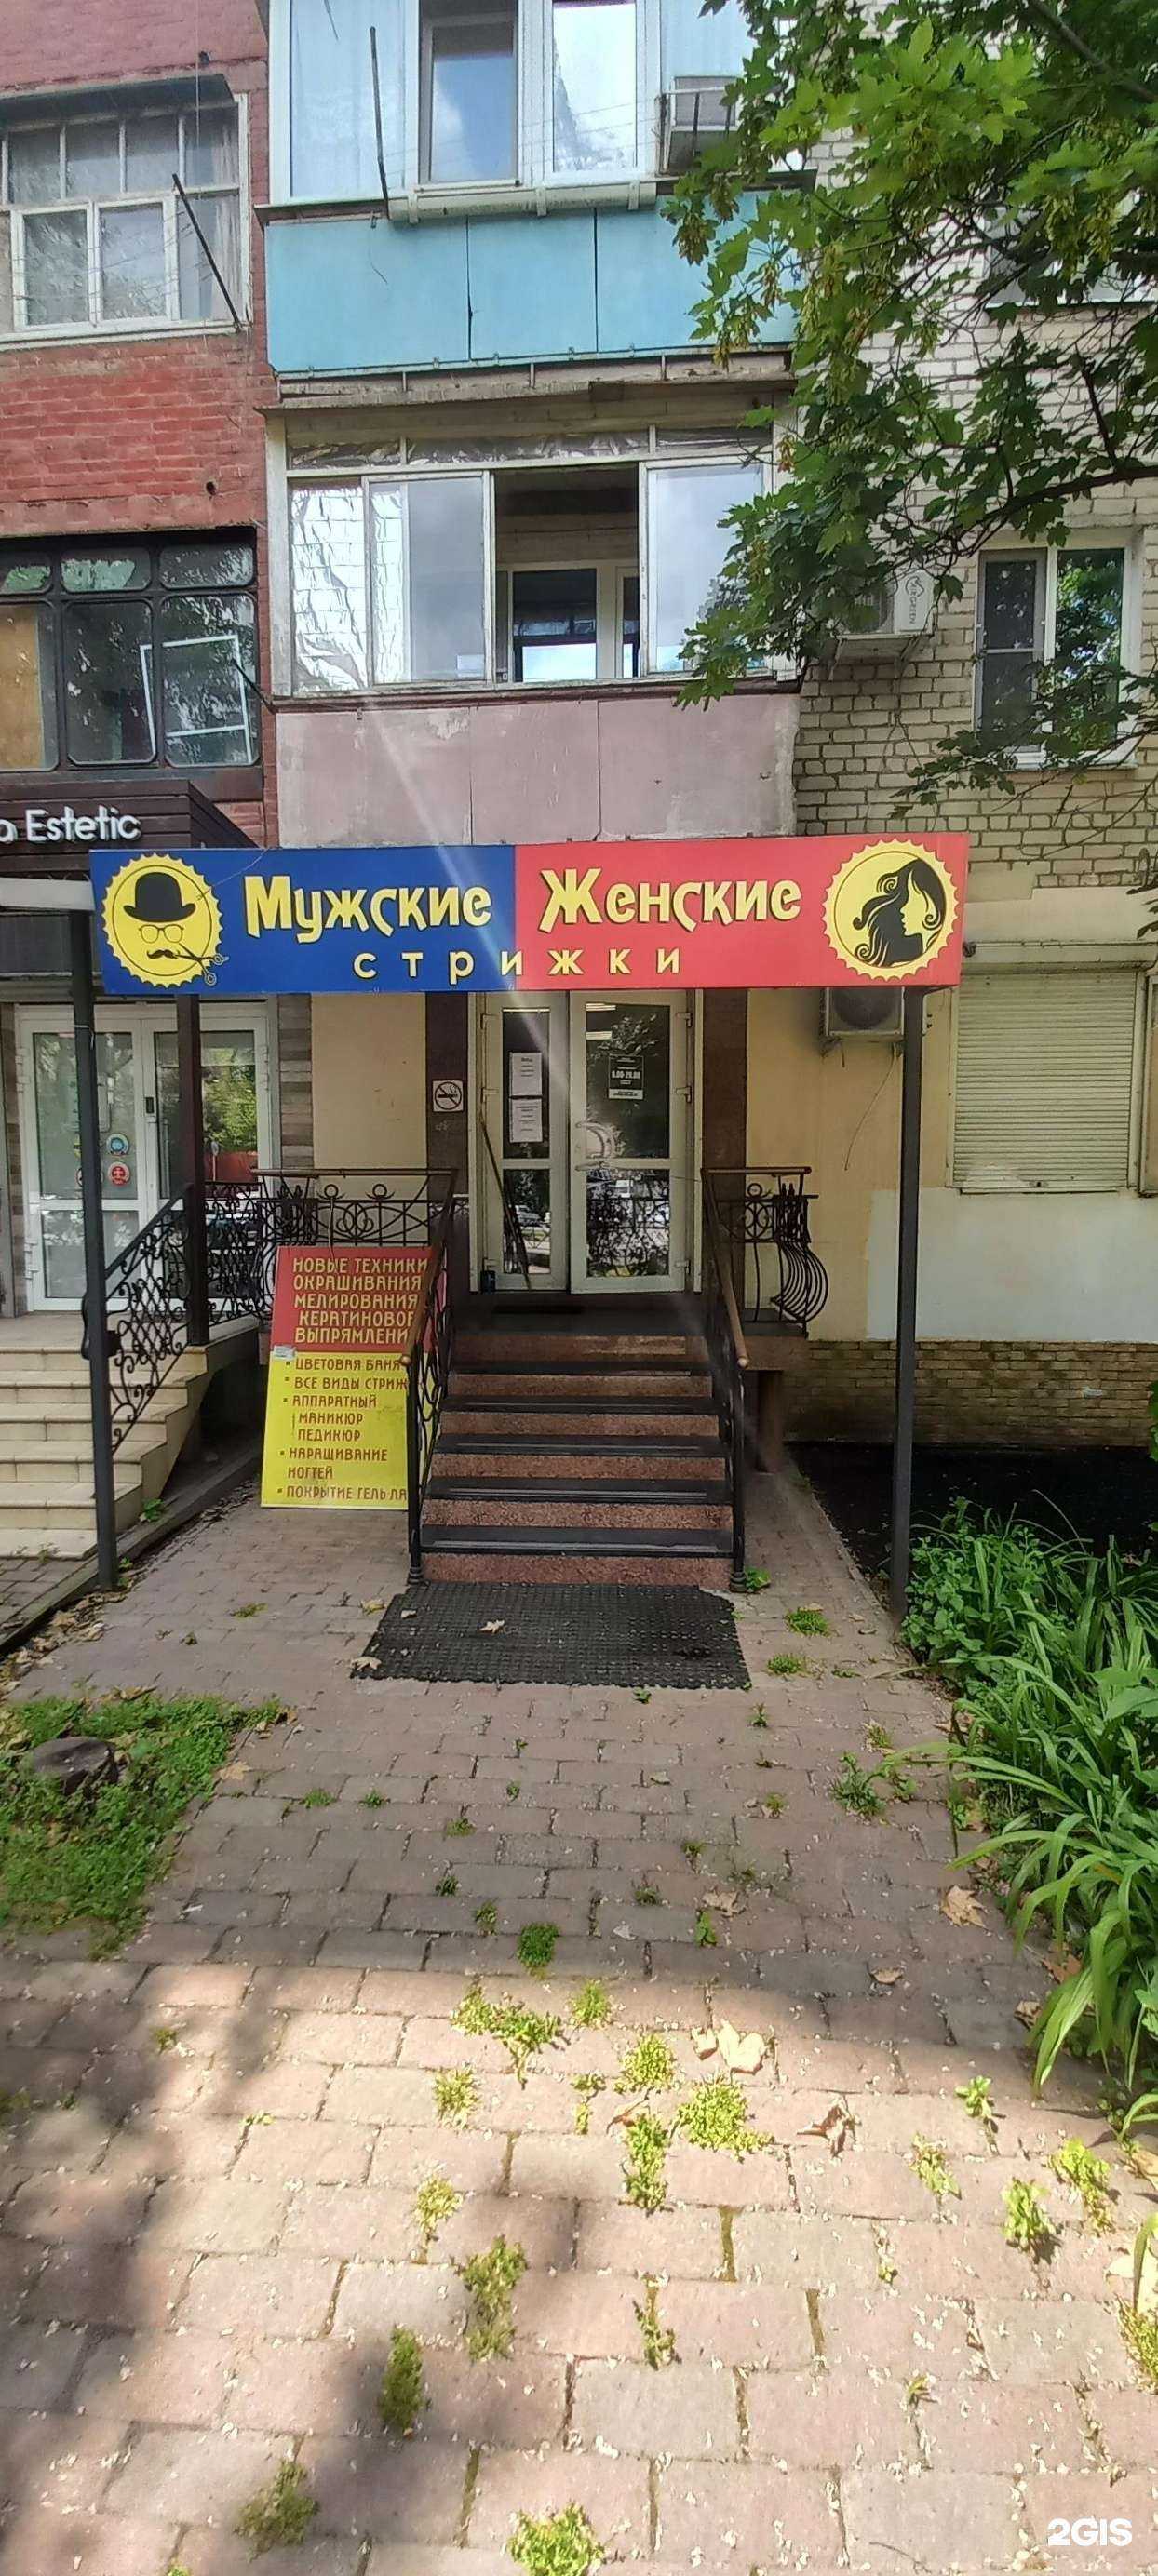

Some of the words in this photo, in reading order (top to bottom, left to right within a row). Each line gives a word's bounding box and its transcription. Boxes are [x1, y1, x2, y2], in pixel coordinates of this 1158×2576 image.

[25, 805, 141, 842] Estetic
[243, 874, 492, 944] Мужские
[538, 867, 802, 933] Женские
[353, 947, 680, 985] стрижки
[293, 1257, 347, 1274] НОВЫЕ
[355, 1257, 428, 1274] ТЕХНИКИ
[293, 1274, 422, 1292] ОКРАШИВАНИЯ
[294, 1293, 418, 1309] МЕЛИРОВАНИЯ
[295, 1327, 410, 1344] ВЫПРЯМЛЕНИ
[295, 1358, 361, 1372] ЦВЕТОВАЯ
[366, 1359, 400, 1371] БАНЯ
[294, 1376, 317, 1390] ВСЕ
[323, 1377, 360, 1391] ВИДЫ
[365, 1377, 407, 1390] СТРИЖ
[292, 1394, 377, 1408] АППАРАТНЫЙ
[298, 1413, 363, 1425] МАНИКЮР
[298, 1429, 361, 1442] ПЕДИКЮР
[289, 1448, 388, 1462] НАРАЩИВАНИЕ
[287, 1465, 333, 1481] НОГТЕЙ
[286, 1486, 353, 1501] ПОКРЫТИЕ
[357, 1487, 386, 1500] ГЕЛЬ
[389, 1488, 407, 1501] ЛА
